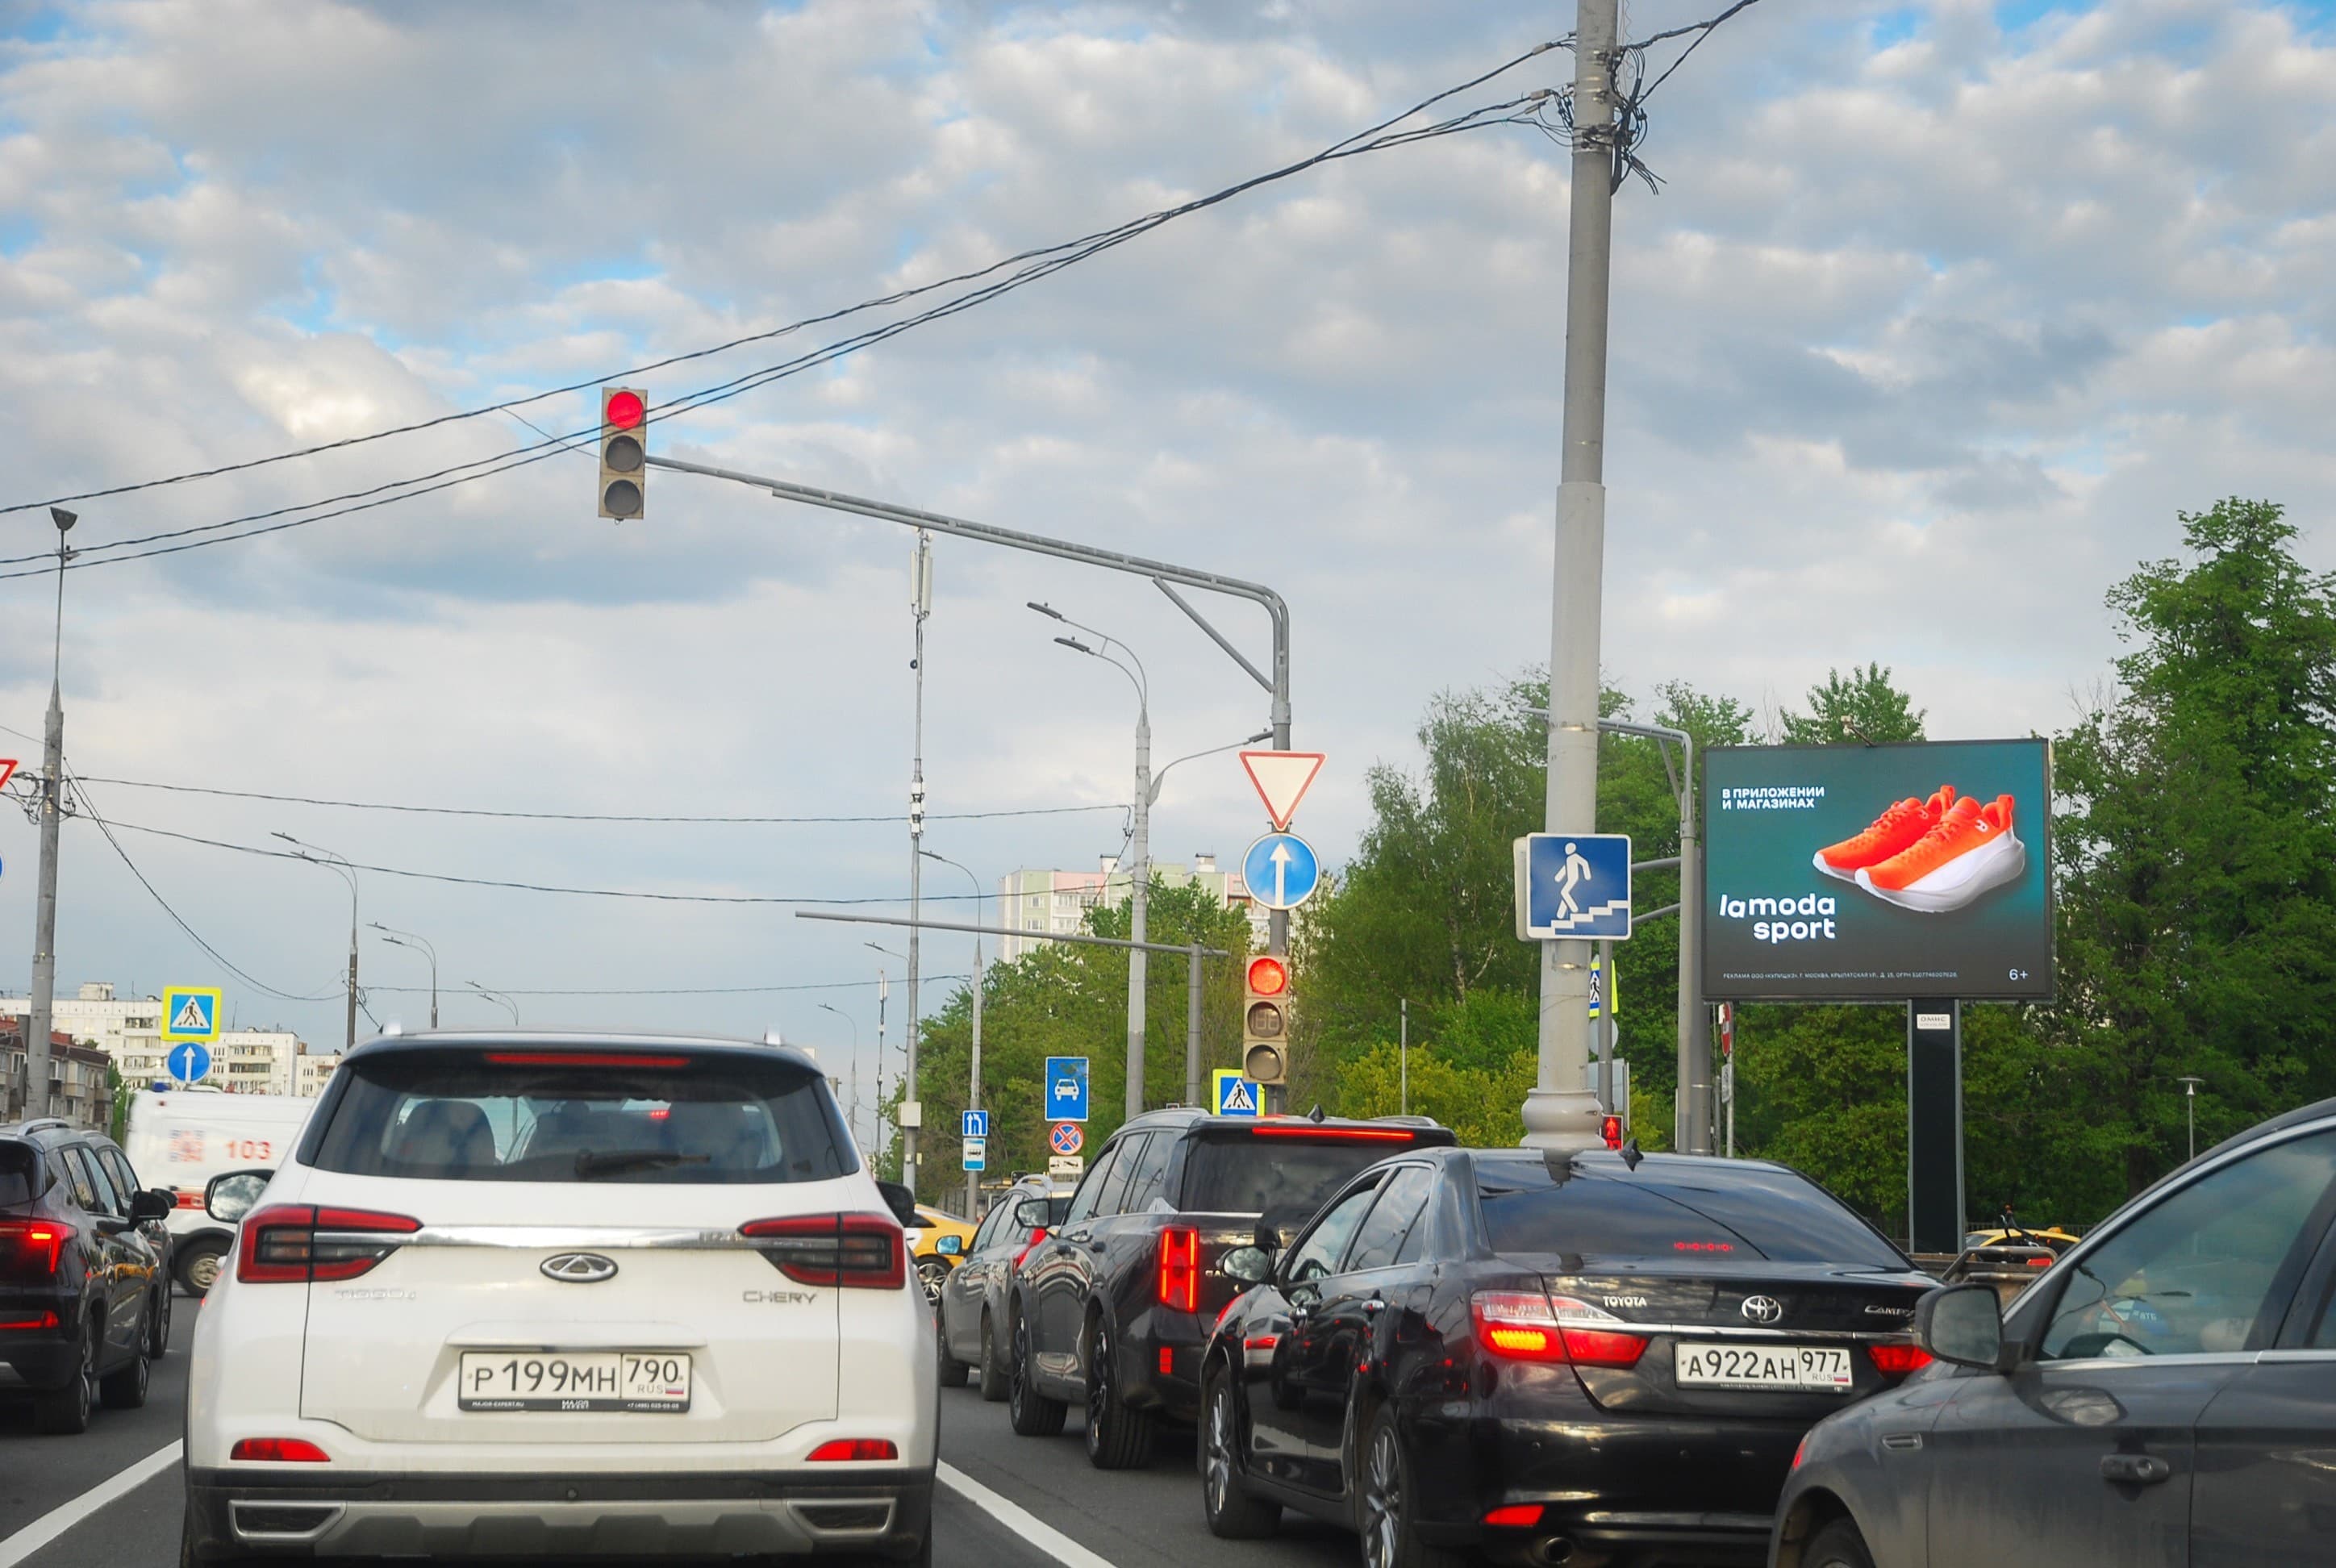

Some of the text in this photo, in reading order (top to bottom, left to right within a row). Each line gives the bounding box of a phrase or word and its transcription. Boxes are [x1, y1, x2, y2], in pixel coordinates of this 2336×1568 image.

[1722, 786, 1825, 799] В ПРИЛОЖЕНИИ
[1722, 798, 1815, 809] И МАГАЗИНАХ
[1719, 893, 1836, 918] lamoda
[1753, 918, 1836, 944] sport
[2009, 968, 2029, 981] 6+
[225, 1140, 272, 1160] 103
[742, 1291, 817, 1303] CHERY
[1602, 1295, 1647, 1307] TOYOTA
[1800, 1351, 1842, 1373] 977
[625, 1357, 679, 1383] 790
[1812, 1374, 1833, 1382] RUS
[637, 1384, 664, 1395] RUS
